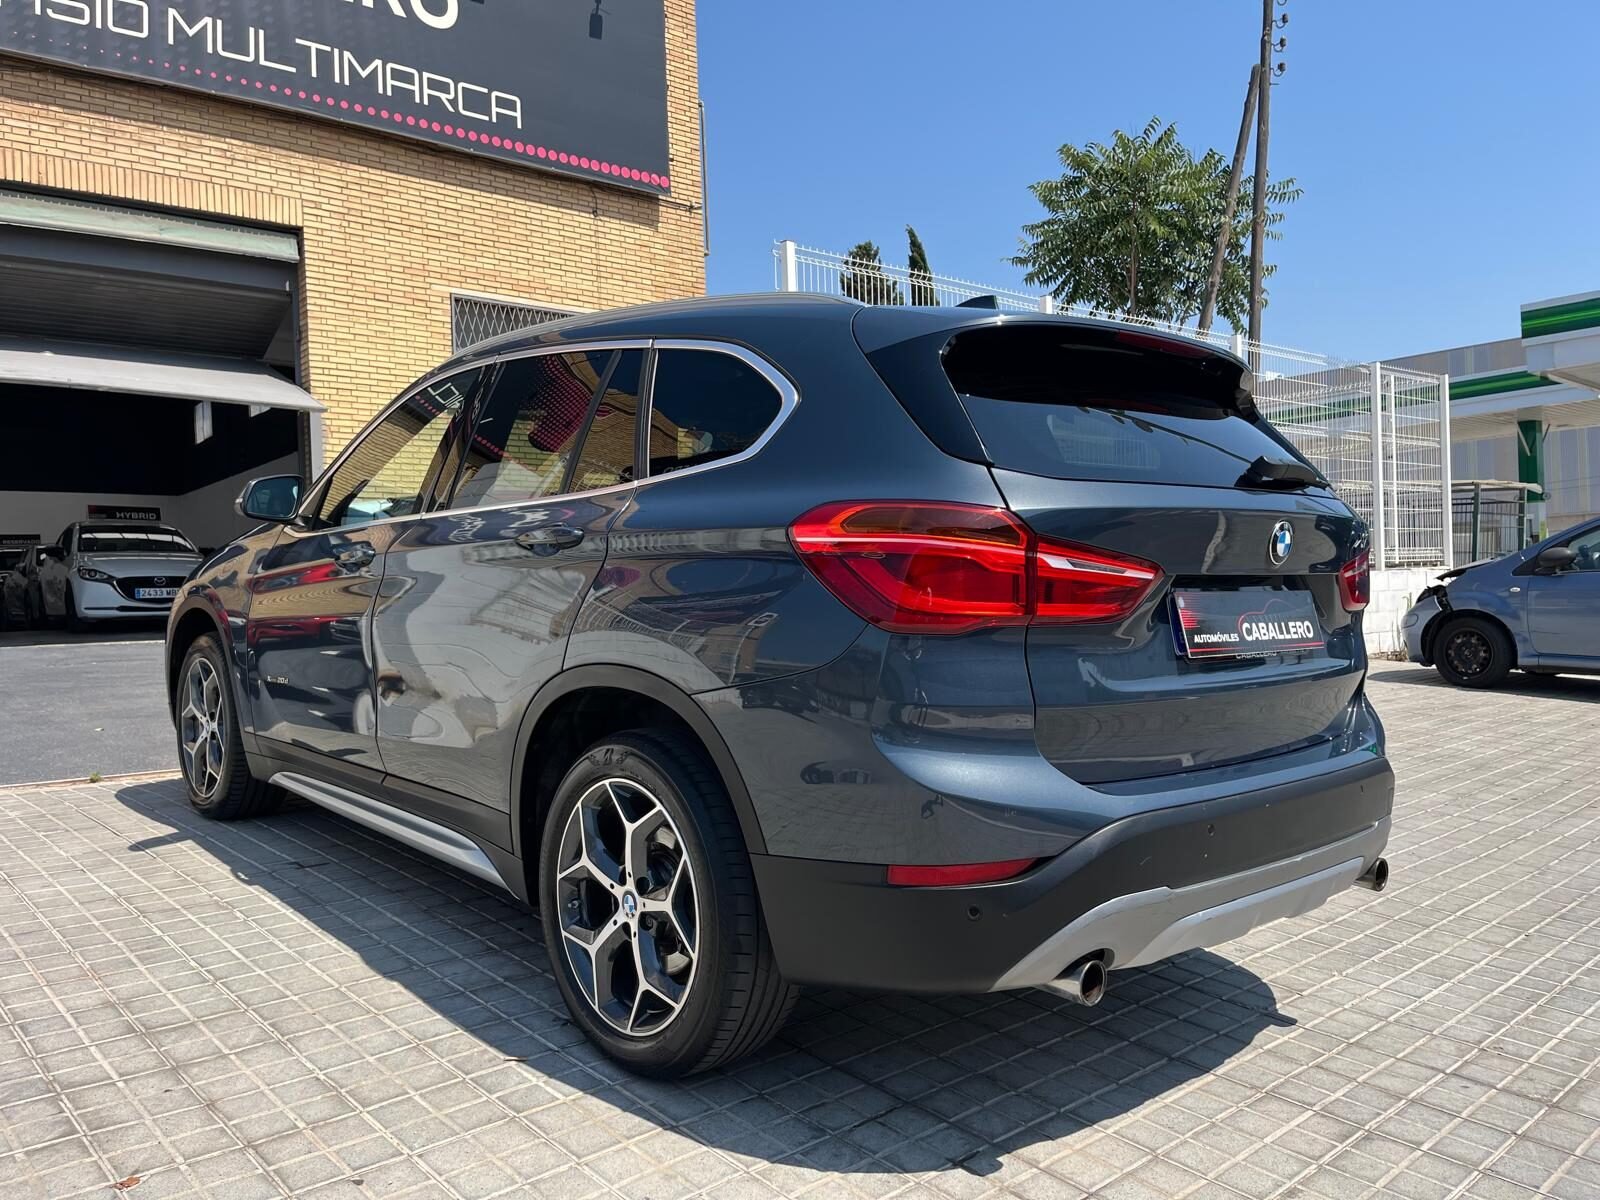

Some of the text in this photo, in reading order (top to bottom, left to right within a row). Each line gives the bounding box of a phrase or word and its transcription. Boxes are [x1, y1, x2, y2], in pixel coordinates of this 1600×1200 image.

[168, 7, 522, 129] MULTIMARCA
[116, 511, 157, 520] HYBRID
[1194, 631, 1240, 643] AUTOMÓVILES
[1242, 620, 1314, 641] CABALLERO
